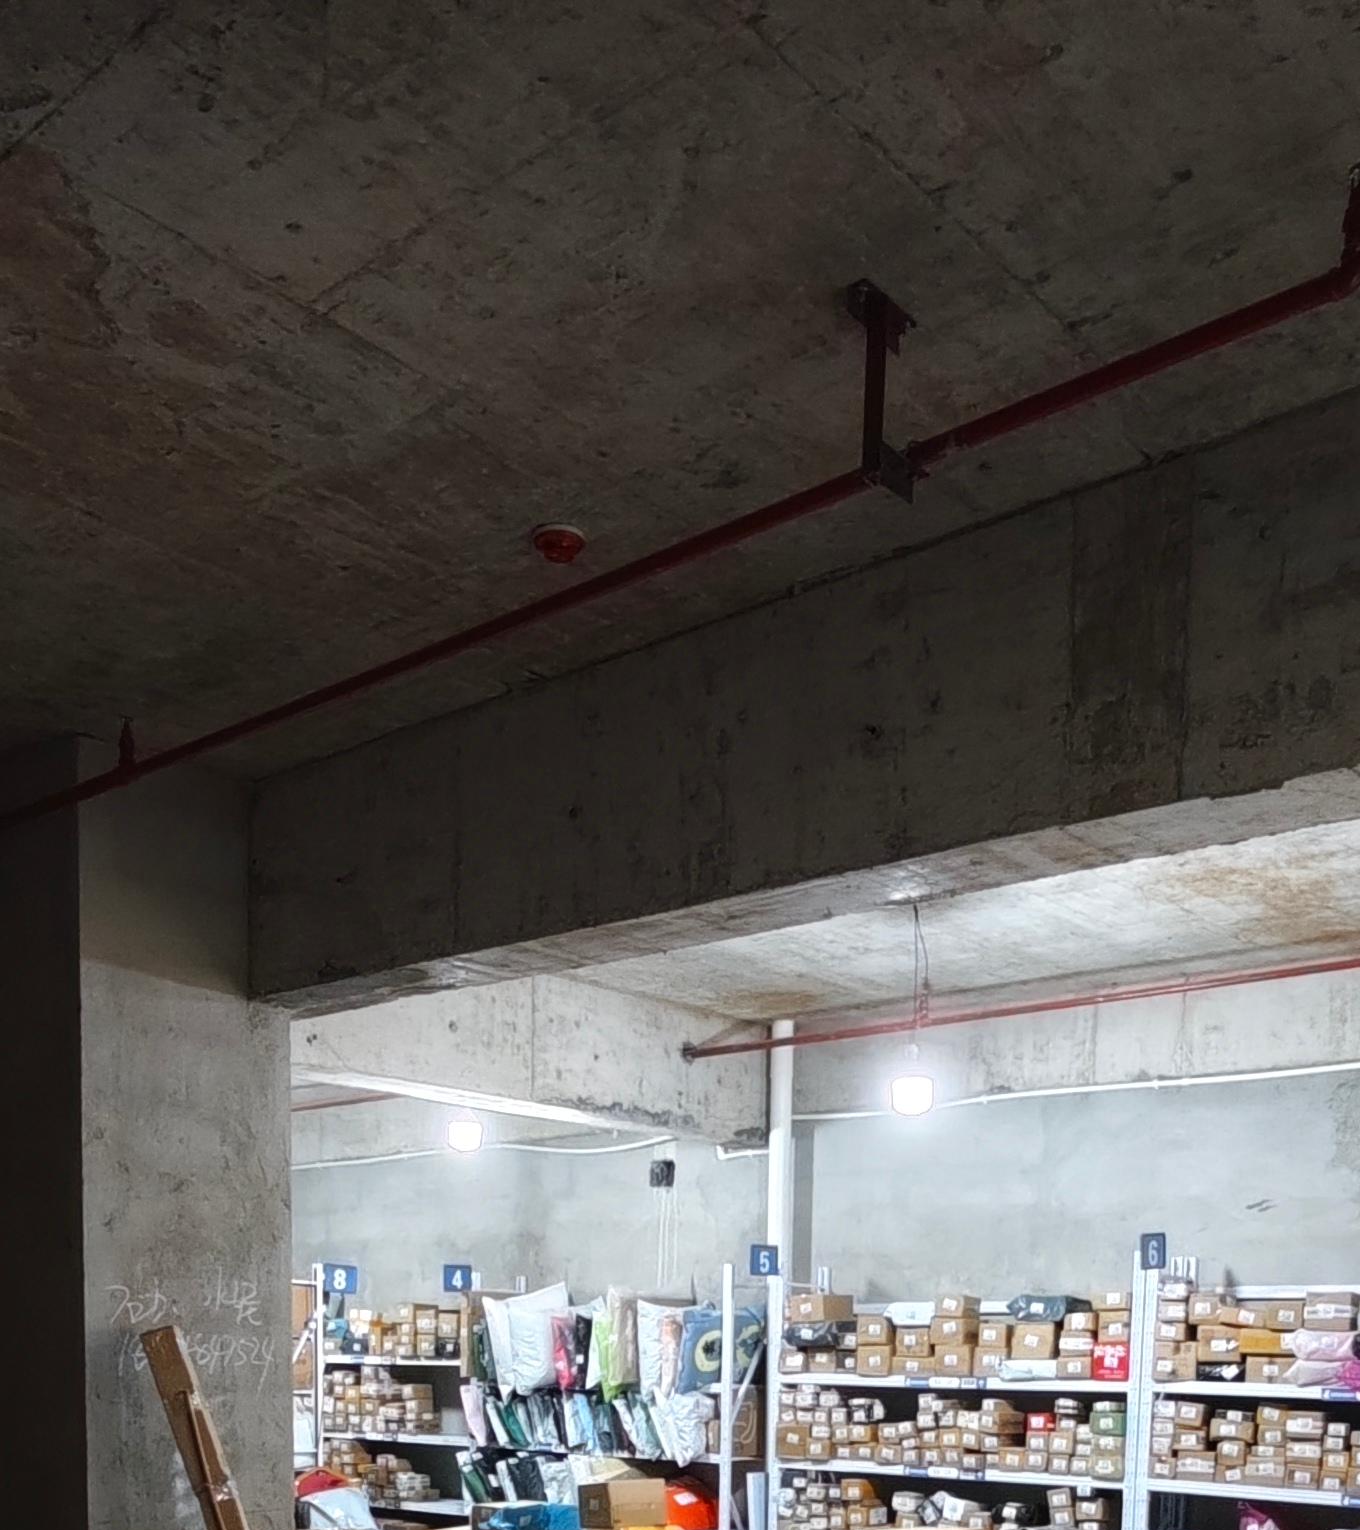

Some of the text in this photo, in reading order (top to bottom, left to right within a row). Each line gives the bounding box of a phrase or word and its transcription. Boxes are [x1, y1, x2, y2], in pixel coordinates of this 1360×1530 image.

[759, 1251, 770, 1274] 5
[1148, 1239, 1159, 1266] 6
[332, 1268, 348, 1290] 8
[451, 1270, 464, 1290] 4
